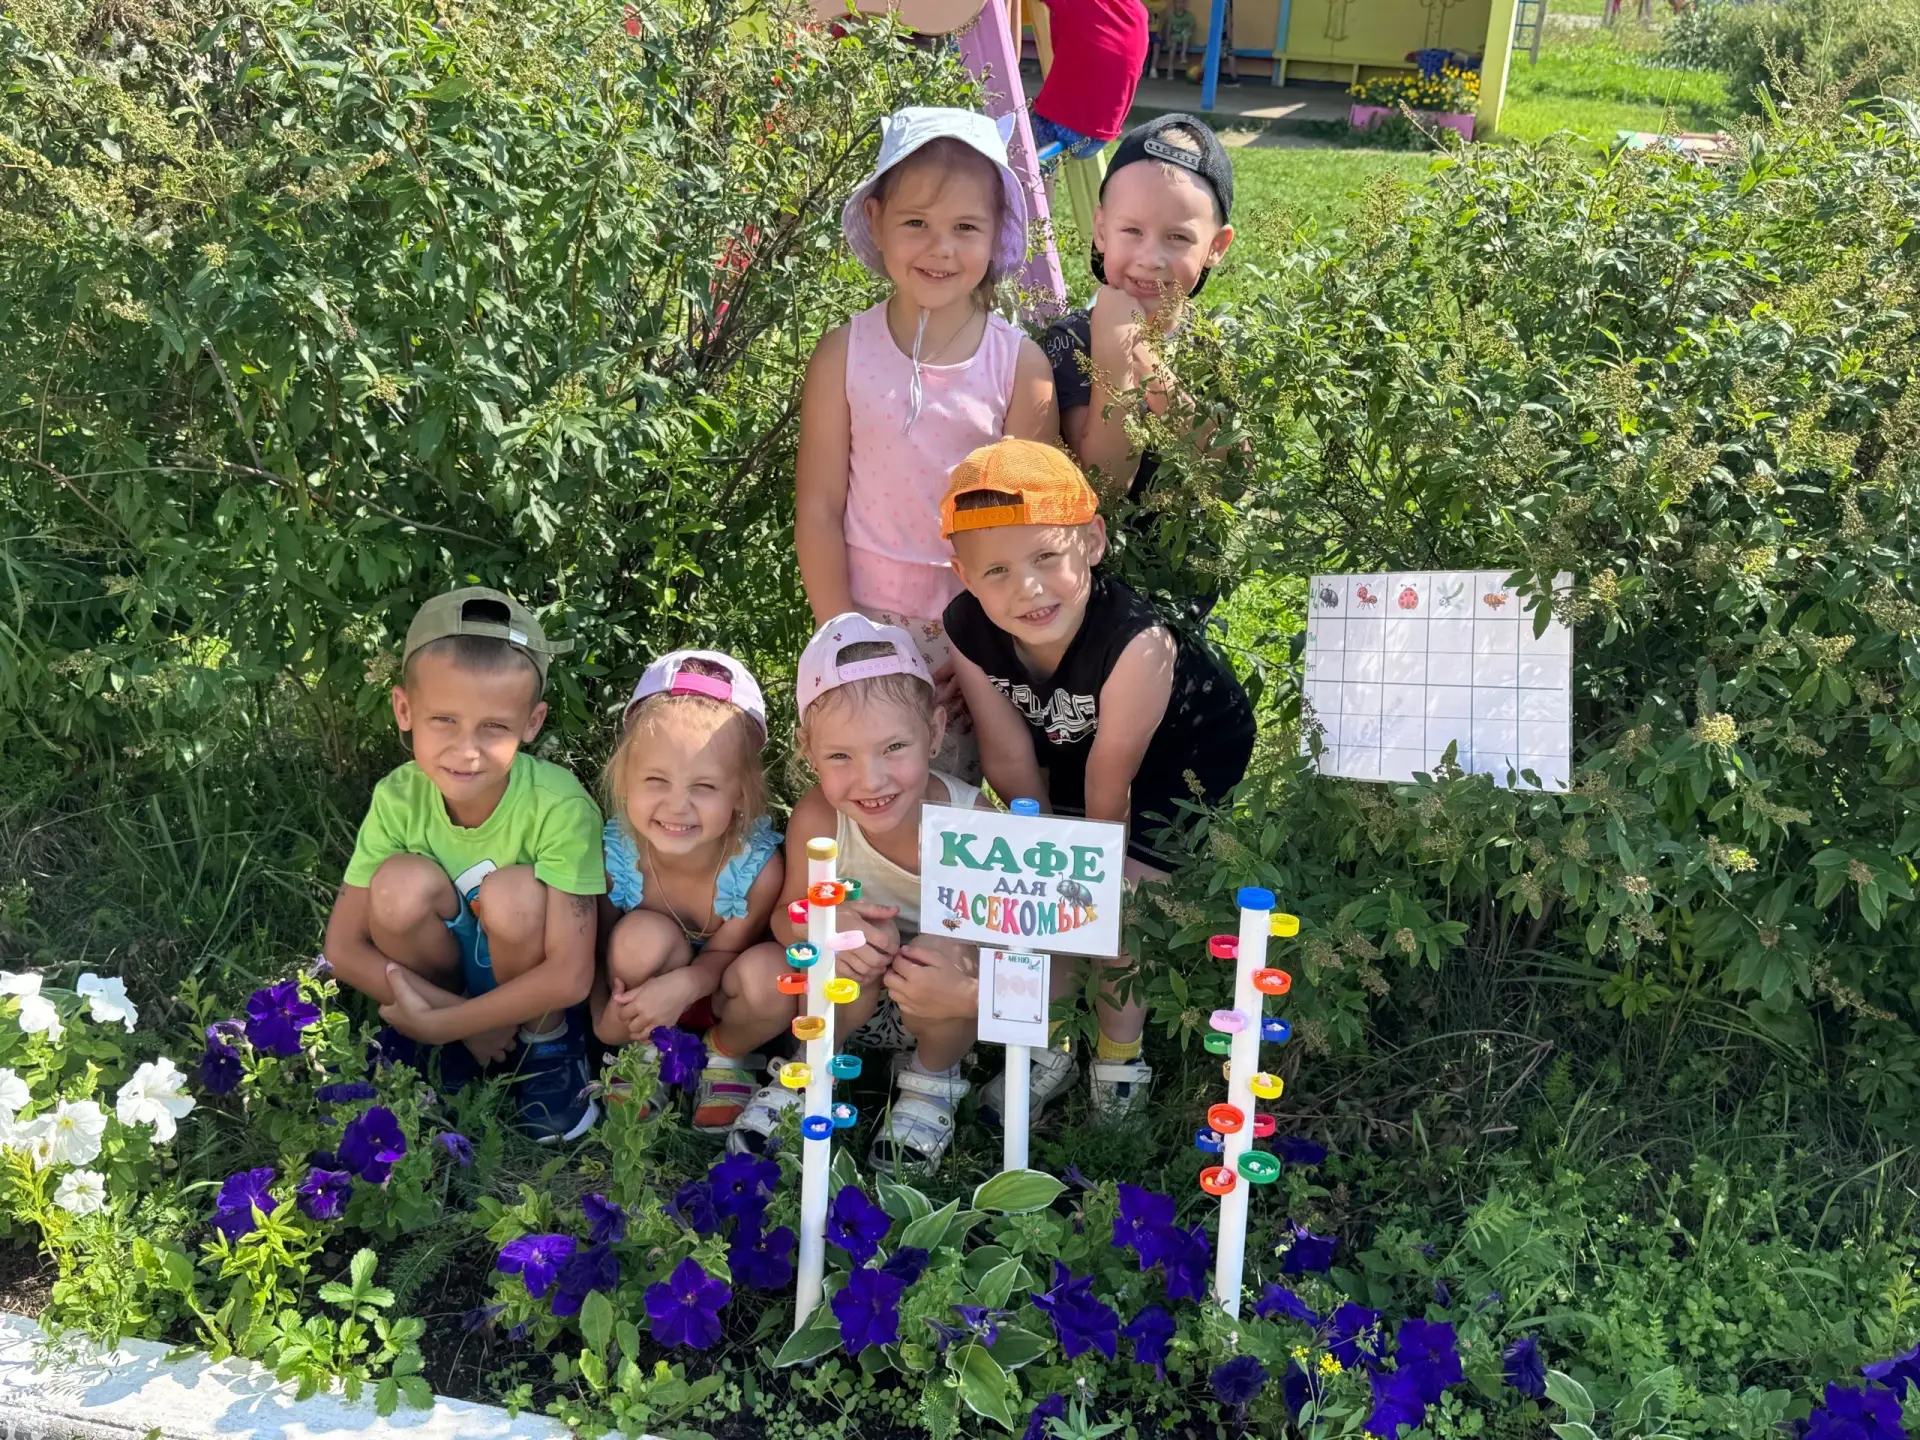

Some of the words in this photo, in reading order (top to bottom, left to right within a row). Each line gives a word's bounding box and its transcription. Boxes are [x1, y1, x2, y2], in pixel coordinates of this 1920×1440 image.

[939, 831, 1105, 883] КАФЕ
[993, 877, 1047, 897] ДЛЯ
[937, 886, 1099, 936] НАСЕКОМЫХ
[1008, 954, 1030, 965] МЕНЮ
